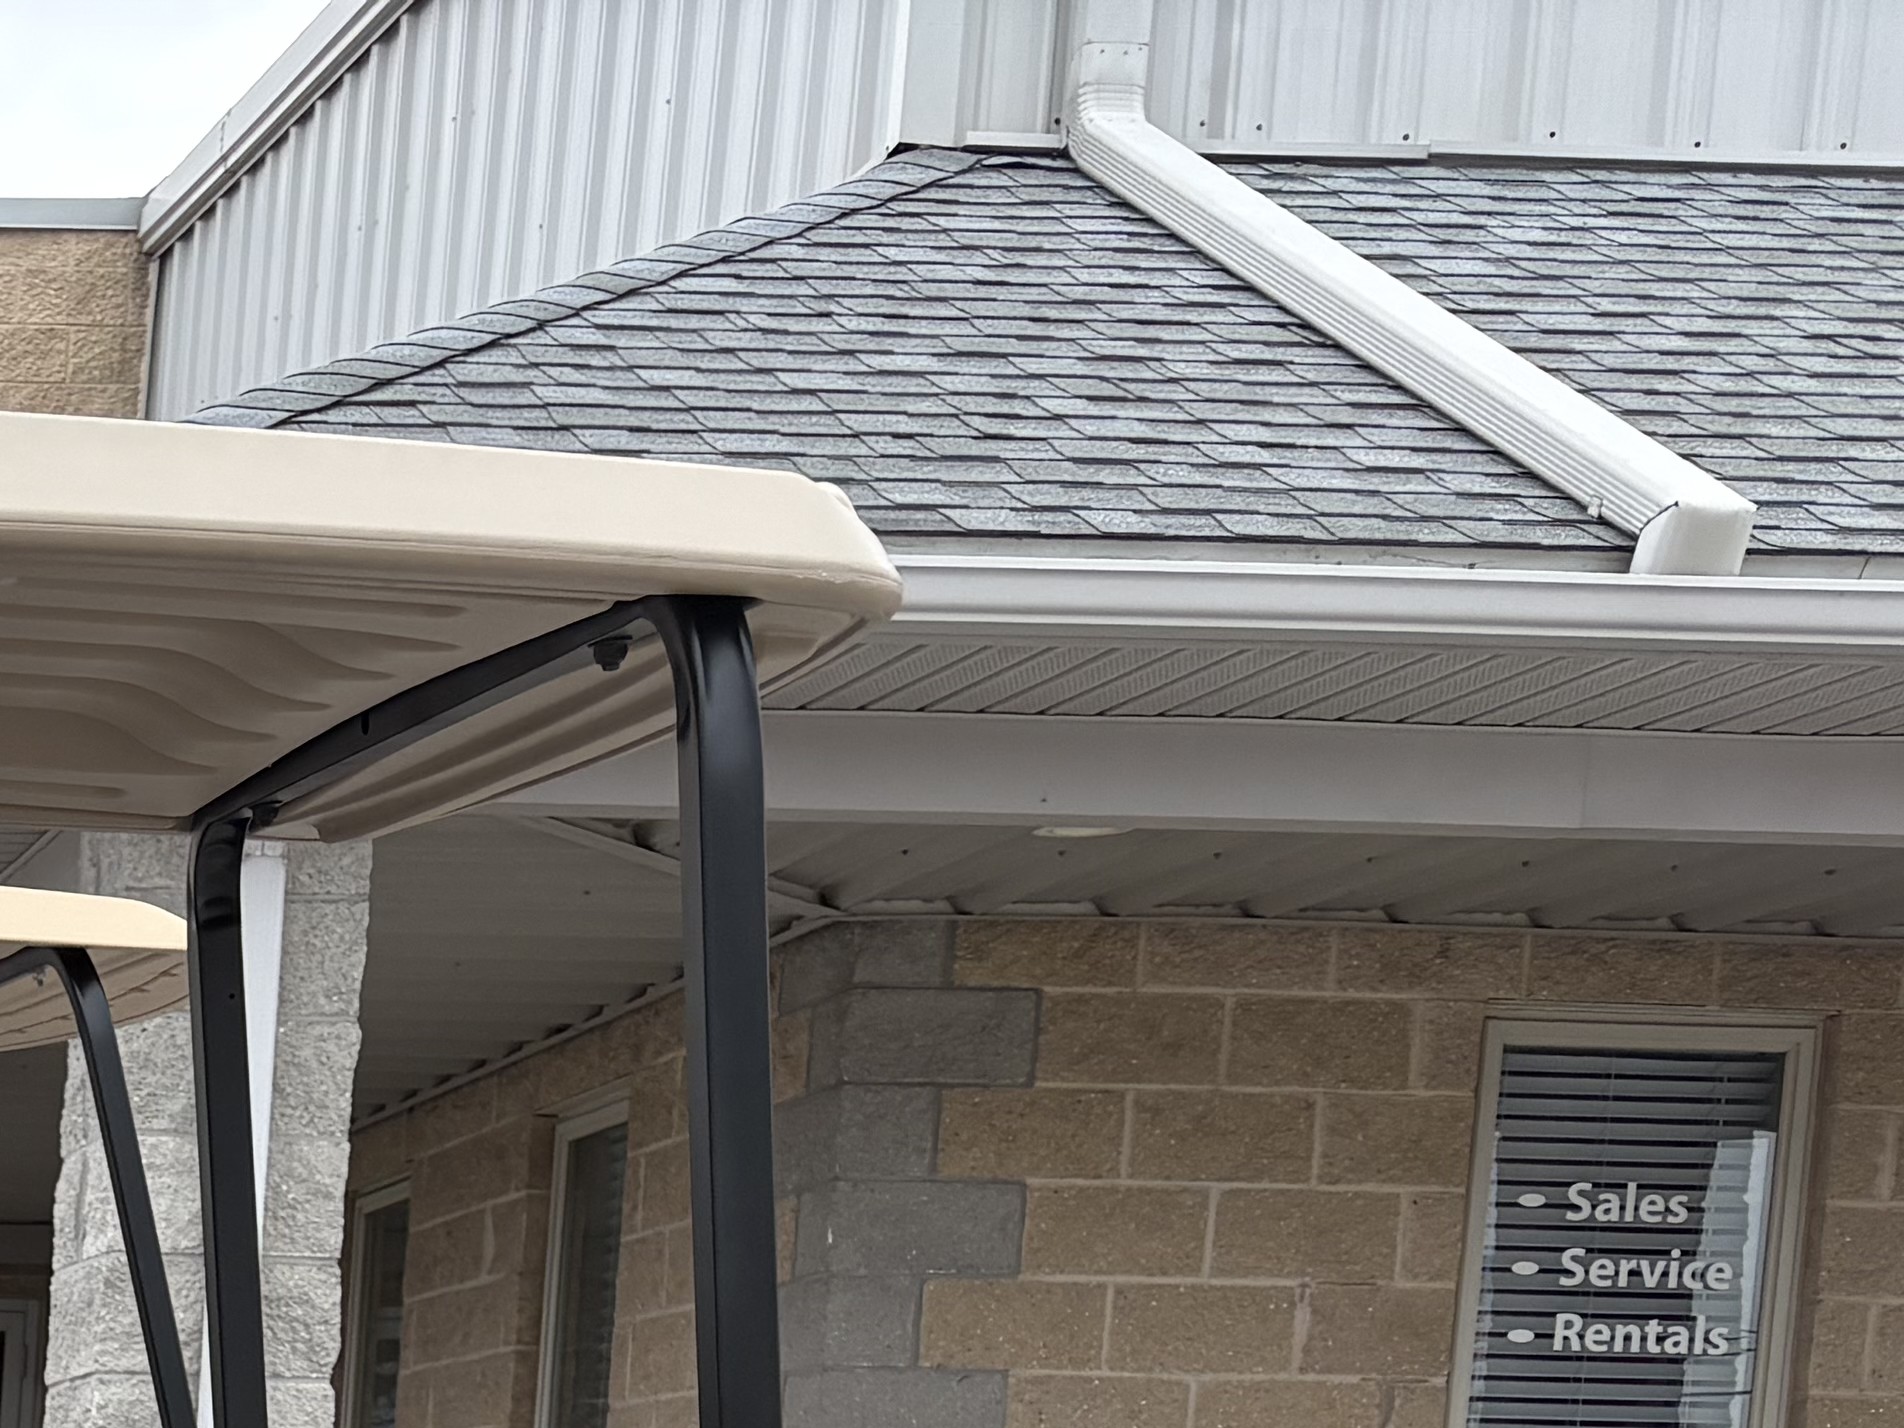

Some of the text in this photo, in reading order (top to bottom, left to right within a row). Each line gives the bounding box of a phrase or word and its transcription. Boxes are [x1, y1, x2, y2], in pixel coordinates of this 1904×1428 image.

[1565, 1181, 1689, 1224] Sales
[1558, 1247, 1734, 1291] Service
[1552, 1312, 1730, 1356] Rentals
